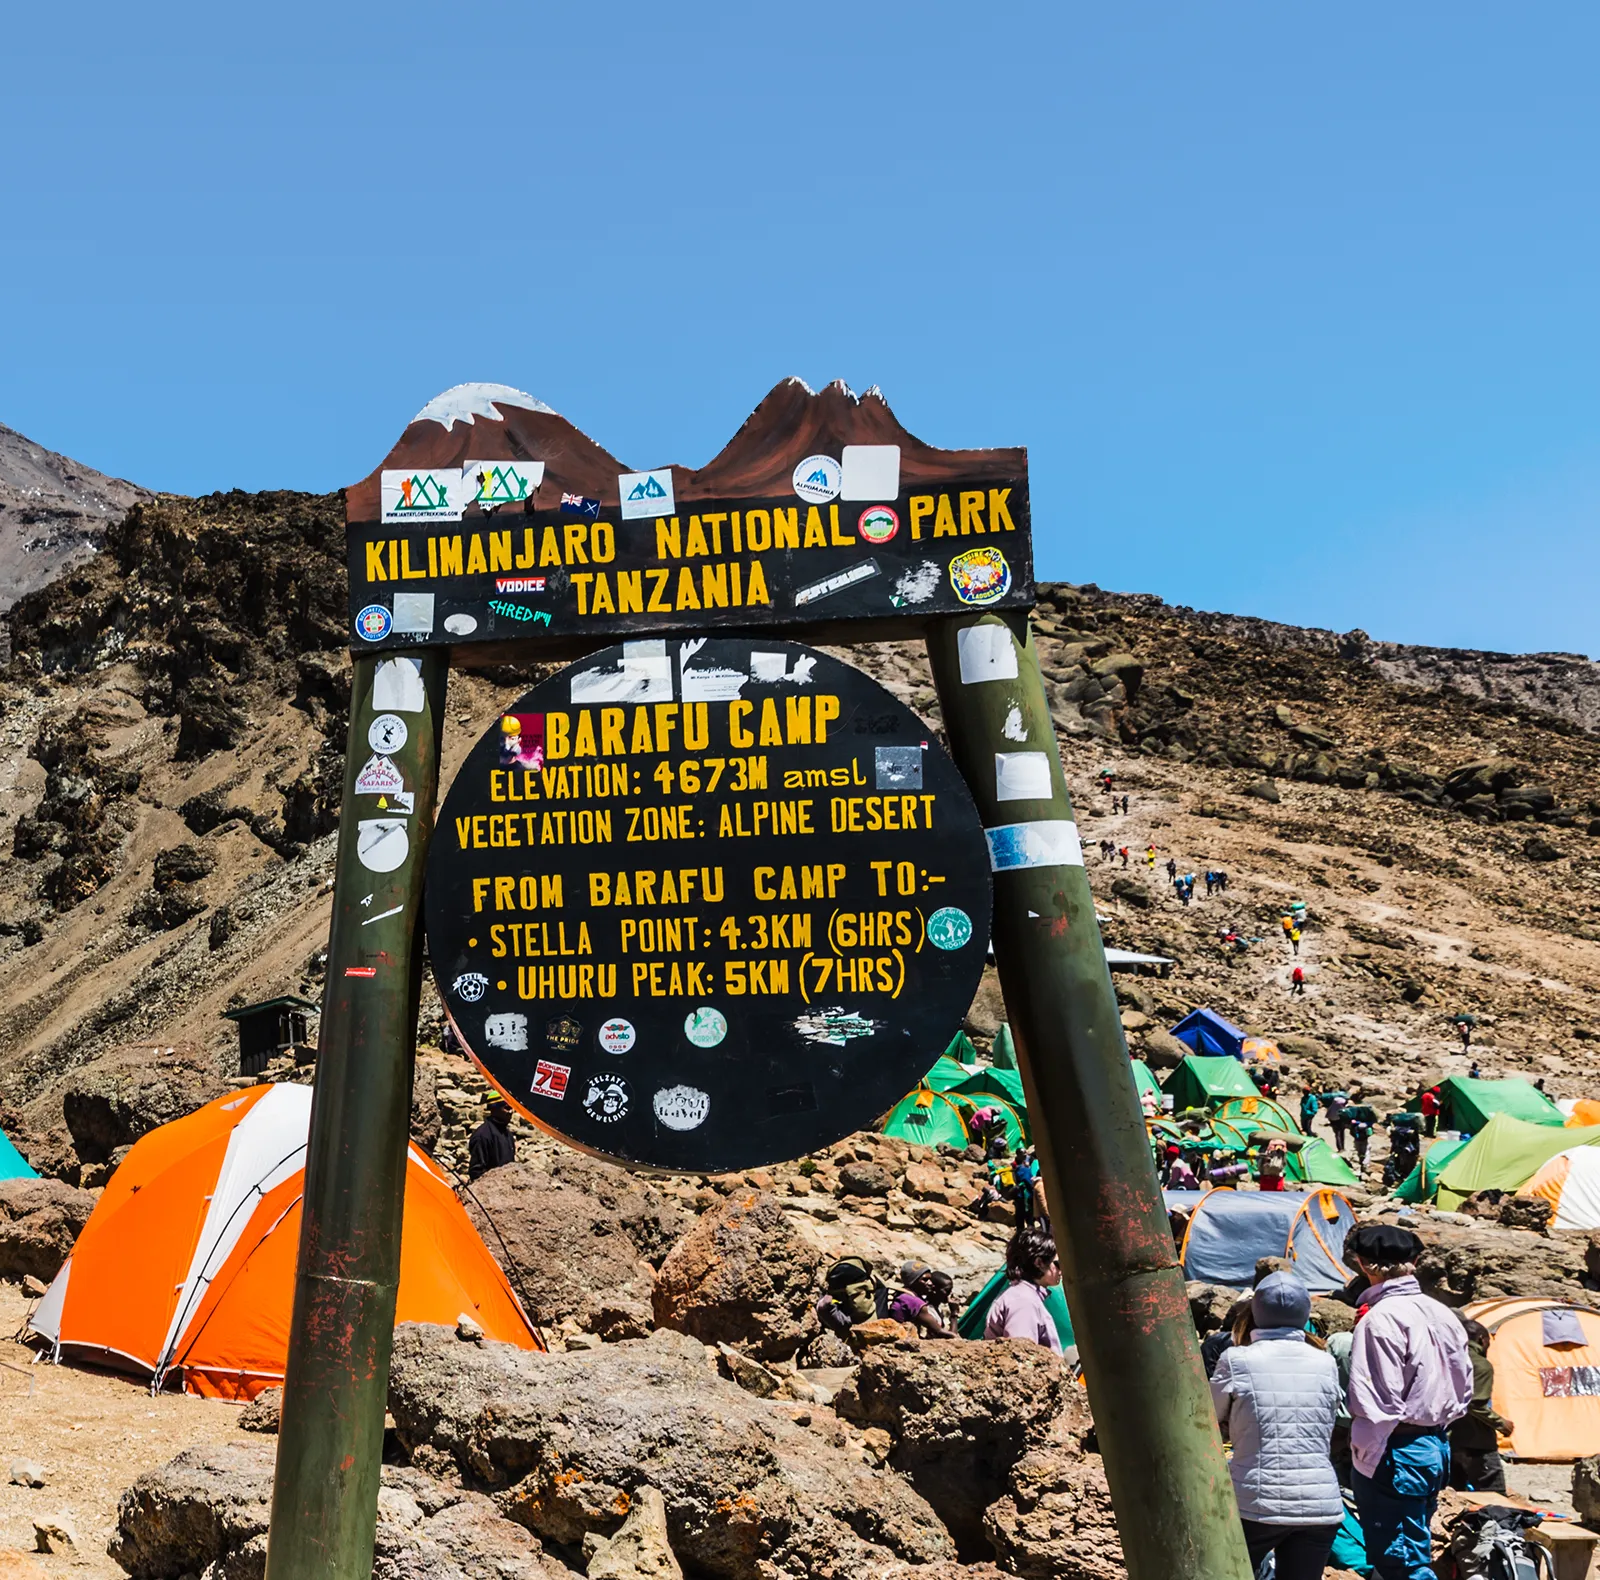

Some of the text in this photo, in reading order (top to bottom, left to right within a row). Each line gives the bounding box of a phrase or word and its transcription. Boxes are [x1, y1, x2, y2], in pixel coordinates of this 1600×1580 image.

[366, 522, 615, 582] KILIMANJARO
[656, 504, 856, 559] NATIONAL
[910, 488, 1015, 540] PARK
[496, 580, 545, 592] VODICE
[571, 561, 770, 615] TANZANIA
[546, 695, 840, 760] BARAFU CAMP
[491, 756, 866, 802] ELEVATION: 4673M amsl
[456, 795, 936, 850] VEGETATION ZONE: ALPINE DESERT
[473, 875, 563, 913] FROM
[589, 867, 725, 907] BARAFU
[754, 864, 846, 901] CAMP
[491, 922, 593, 958] STELLA
[621, 917, 712, 953] POINT:
[720, 914, 812, 951] 4.3KM
[828, 907, 926, 953] (6HRS)
[518, 949, 905, 1004] UHURU PEAK: 5KM (7HRS)
[546, 1034, 579, 1045] THE PRIDE
[535, 1067, 568, 1092] 72
[589, 1074, 626, 1088] ZELZATE
